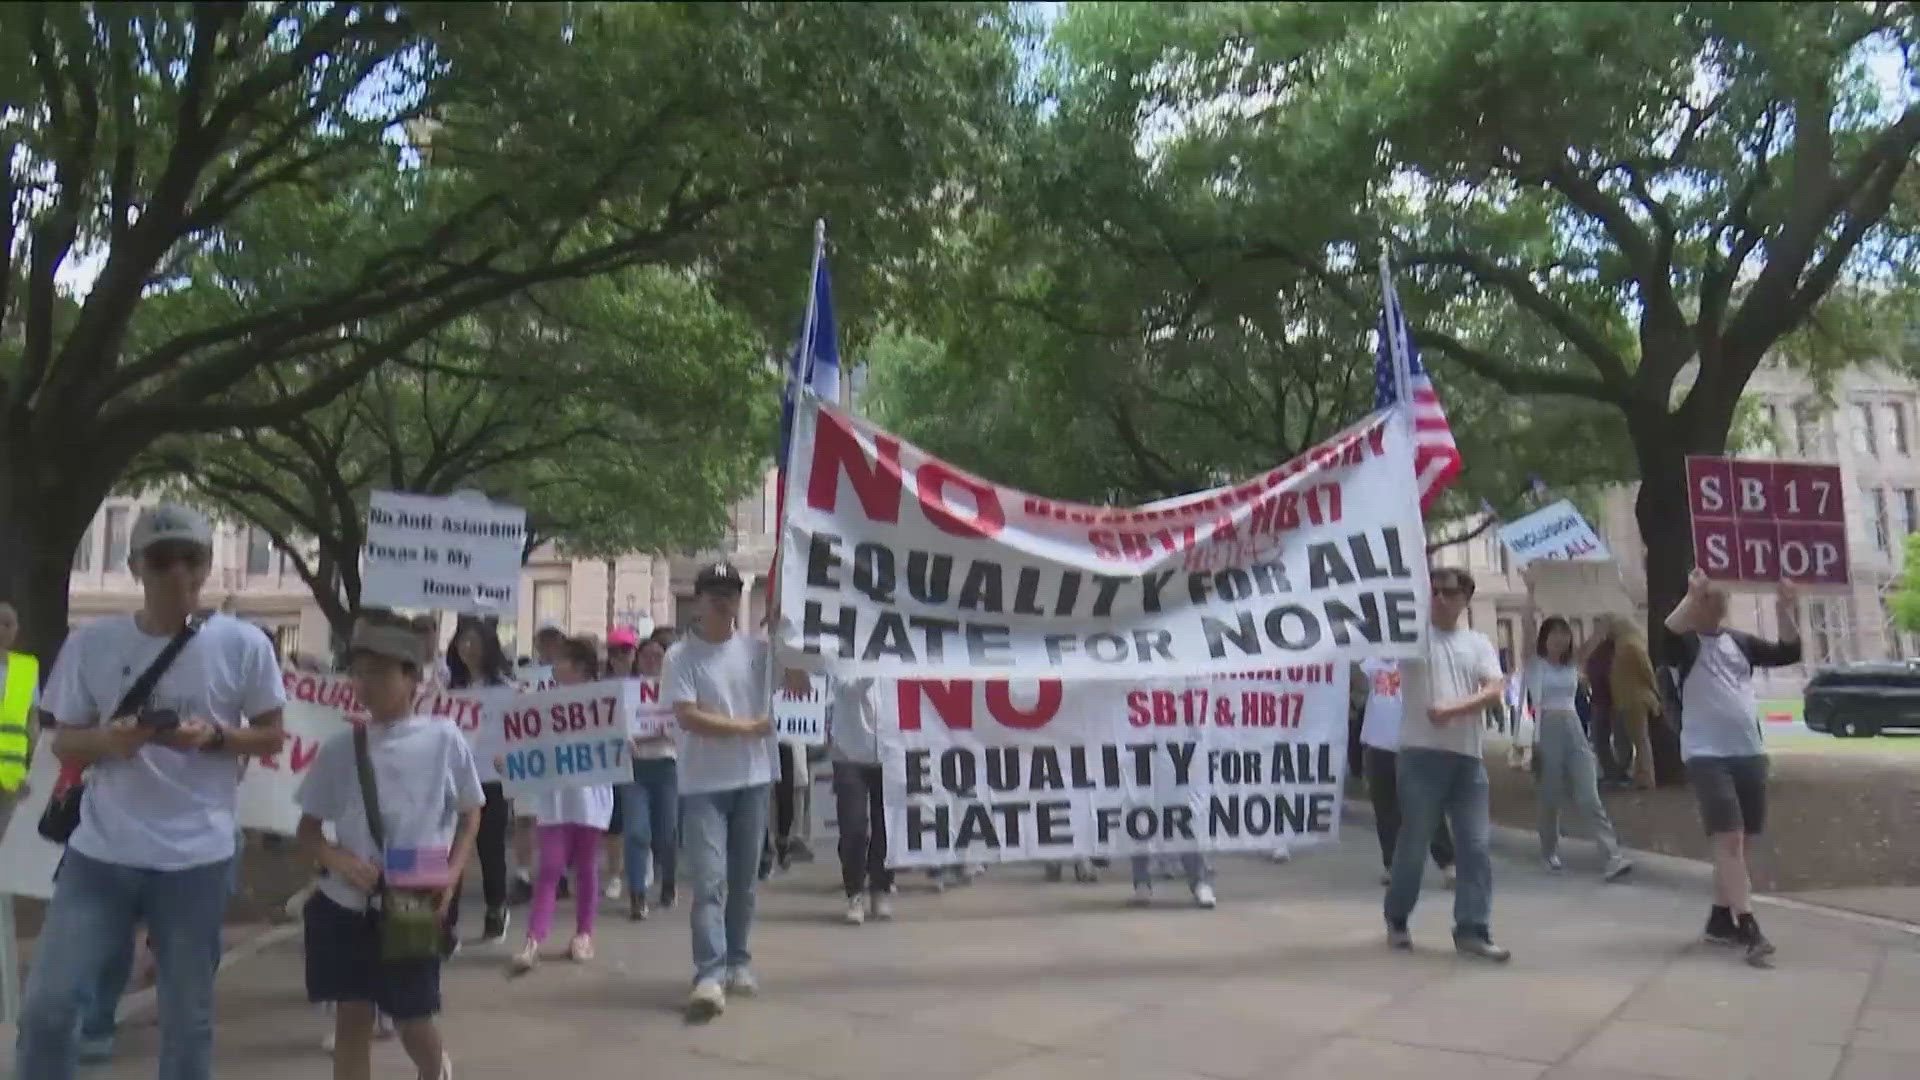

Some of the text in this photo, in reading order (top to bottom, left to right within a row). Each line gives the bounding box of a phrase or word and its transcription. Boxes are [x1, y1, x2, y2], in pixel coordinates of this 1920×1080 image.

[807, 408, 1006, 539] NO
[806, 530, 1175, 616] EQUALITY
[1188, 560, 1292, 605] FOR
[1306, 527, 1412, 591] ALL
[1706, 533, 1838, 577] STOP
[803, 591, 1418, 667] HATE FOR NONE
[503, 707, 542, 742] NO
[551, 696, 618, 734] SB17
[787, 716, 817, 734] BILL
[897, 678, 1063, 731] NO
[1127, 689, 1304, 729] SB17 & HB17
[506, 738, 625, 781] NO HB17
[905, 741, 1337, 799] EQUALITY FOR ALL
[906, 793, 1335, 852] HATE FOR NONE
